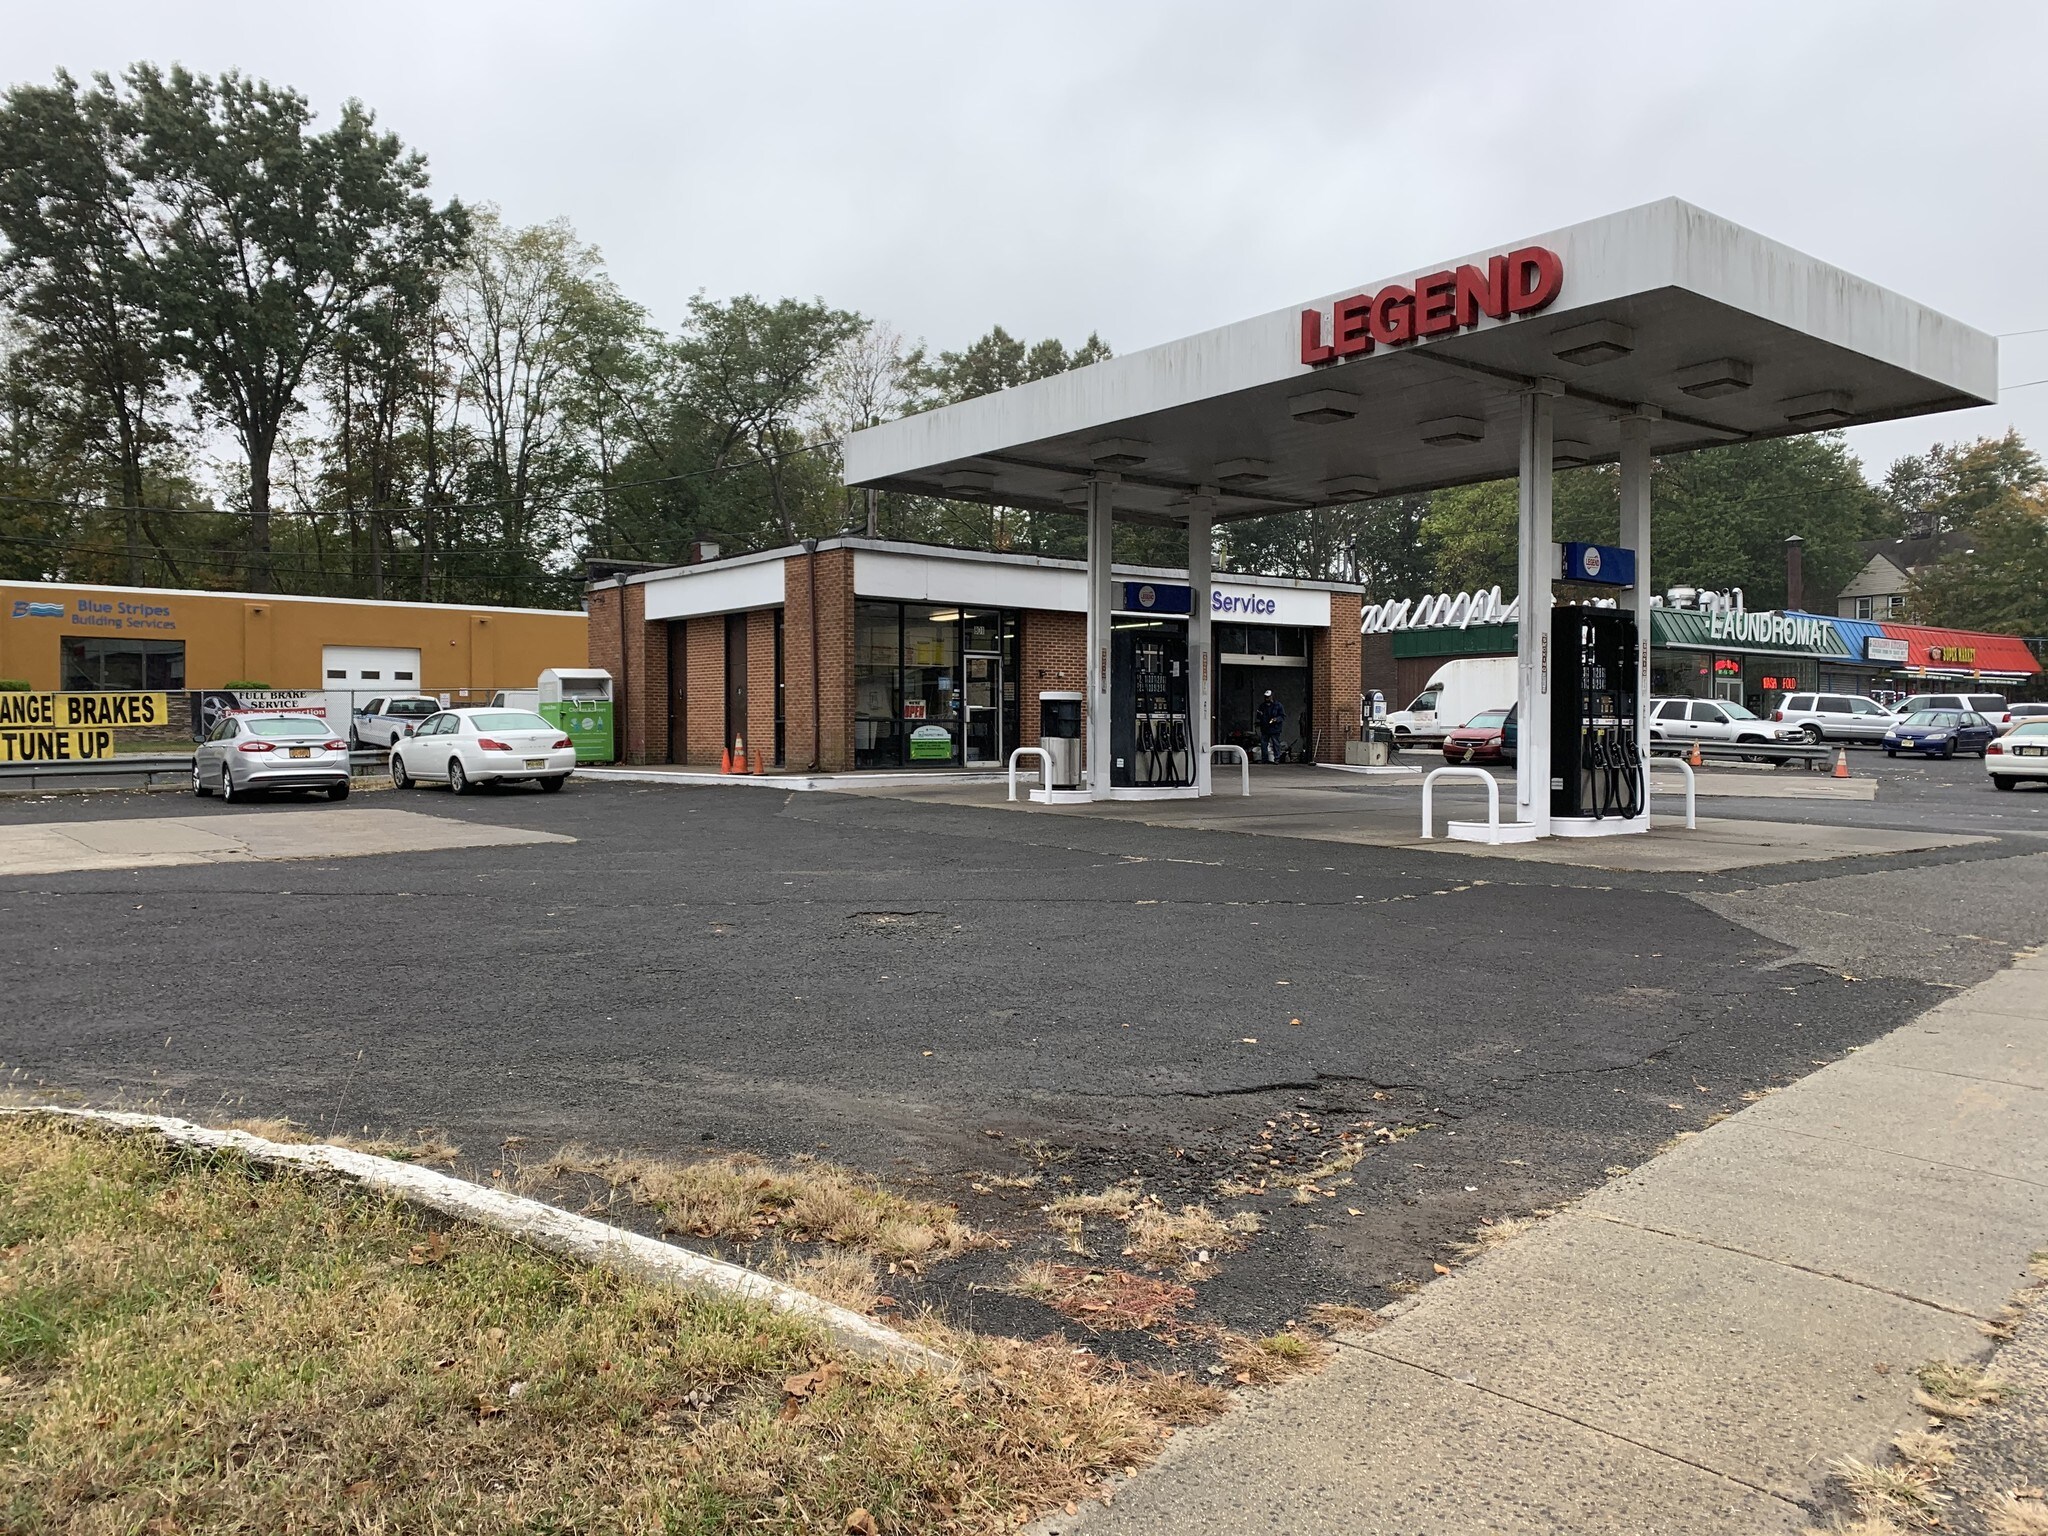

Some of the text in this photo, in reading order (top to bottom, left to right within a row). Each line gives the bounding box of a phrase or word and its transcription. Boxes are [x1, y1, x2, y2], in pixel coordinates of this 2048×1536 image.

[1301, 246, 1564, 366] LEGEND
[78, 599, 170, 618] Blue Stripes
[1211, 590, 1276, 615] Service
[72, 614, 176, 630] Building Services
[1711, 610, 1831, 647] LAUNDROMAT
[1943, 647, 1957, 662] SUPER
[1782, 677, 1797, 689] FOLD
[240, 691, 308, 700] FULL BRAKE
[250, 700, 299, 709] SERVICE
[0, 695, 52, 724] ANGE
[67, 695, 155, 725] BRAKES
[2, 731, 110, 761] TUNE UP
